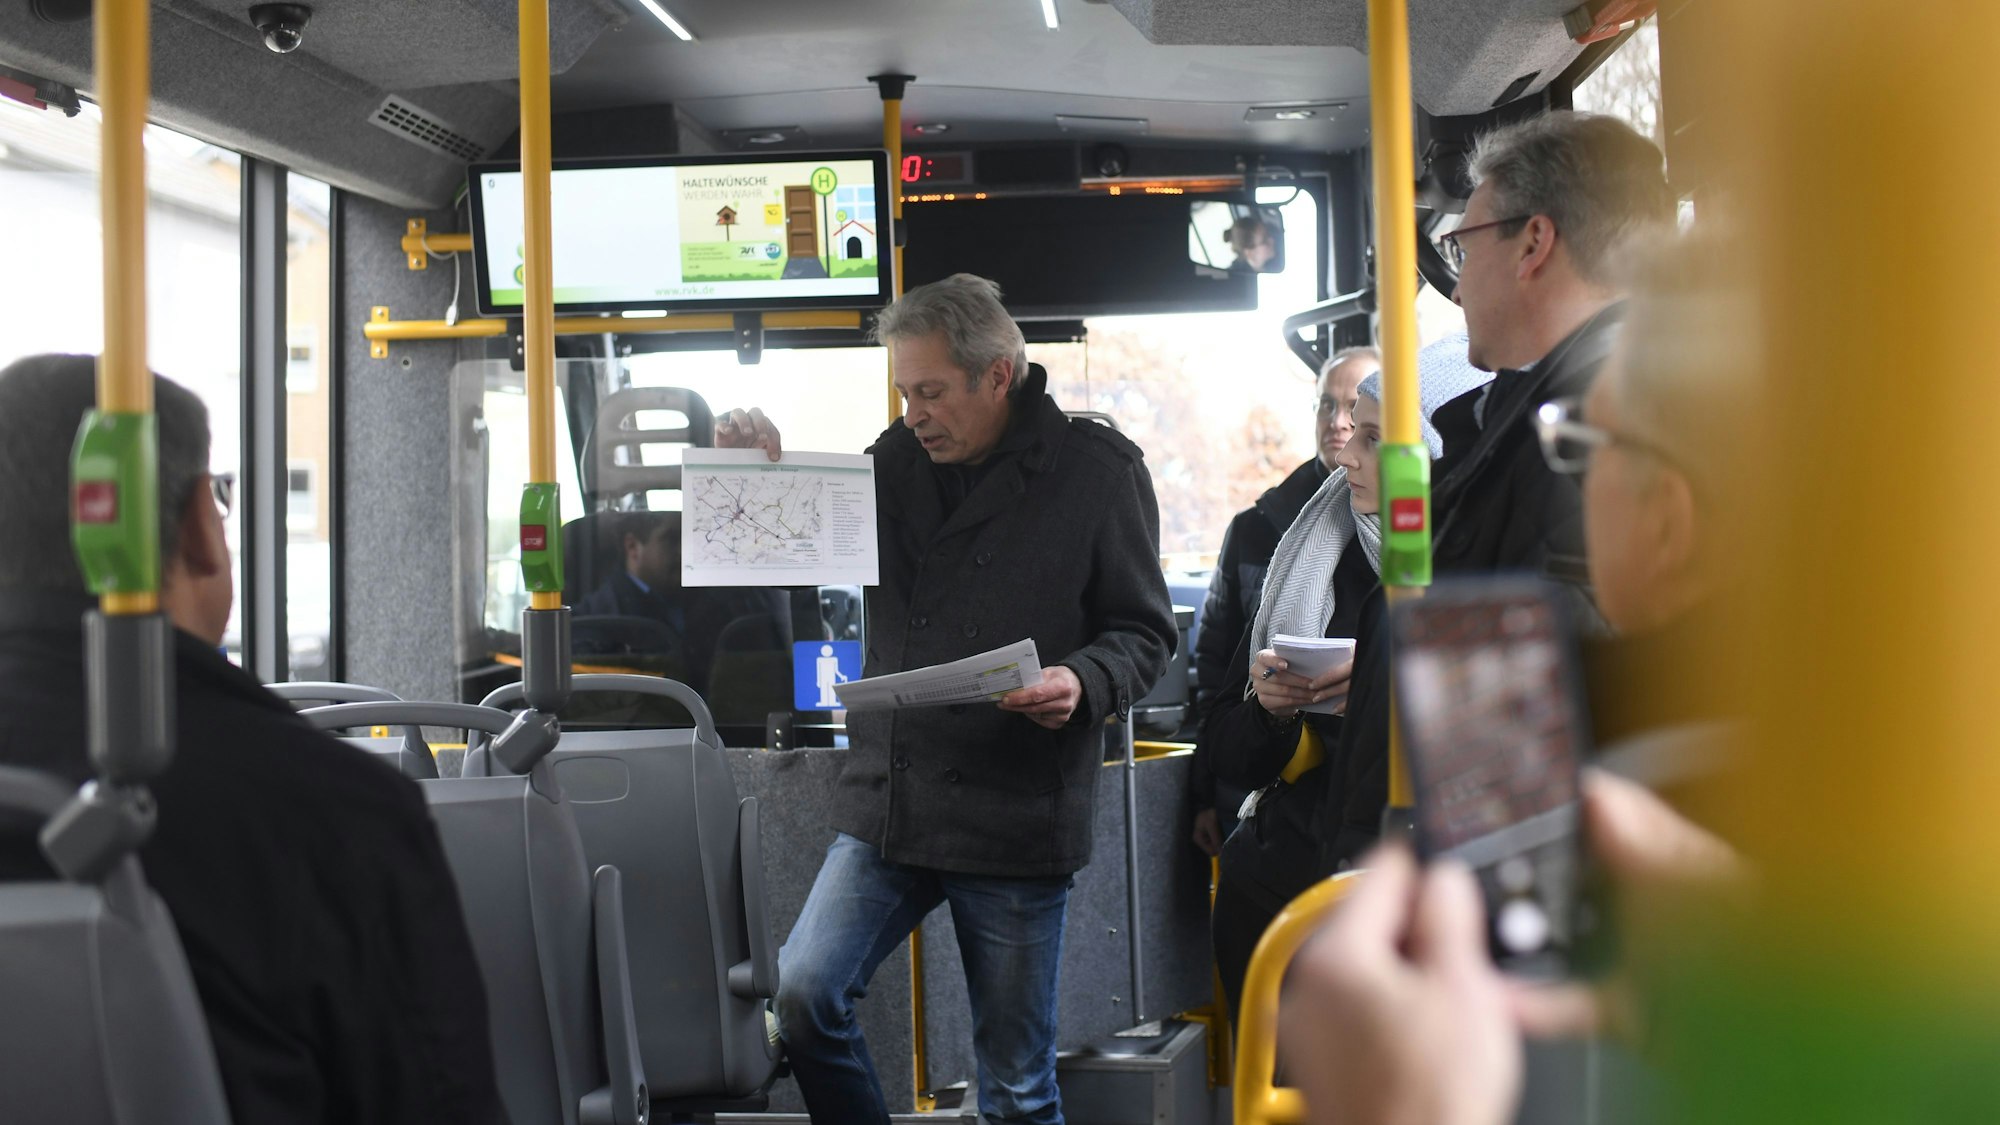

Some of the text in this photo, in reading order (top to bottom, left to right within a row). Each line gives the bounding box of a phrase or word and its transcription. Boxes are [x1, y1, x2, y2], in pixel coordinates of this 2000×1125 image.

[683, 174, 768, 188] HALTEWÜNSCHE
[818, 174, 829, 188] H
[684, 190, 728, 200] WERDEN
[654, 285, 715, 297] www.rvk.de
[524, 538, 542, 546] STOP
